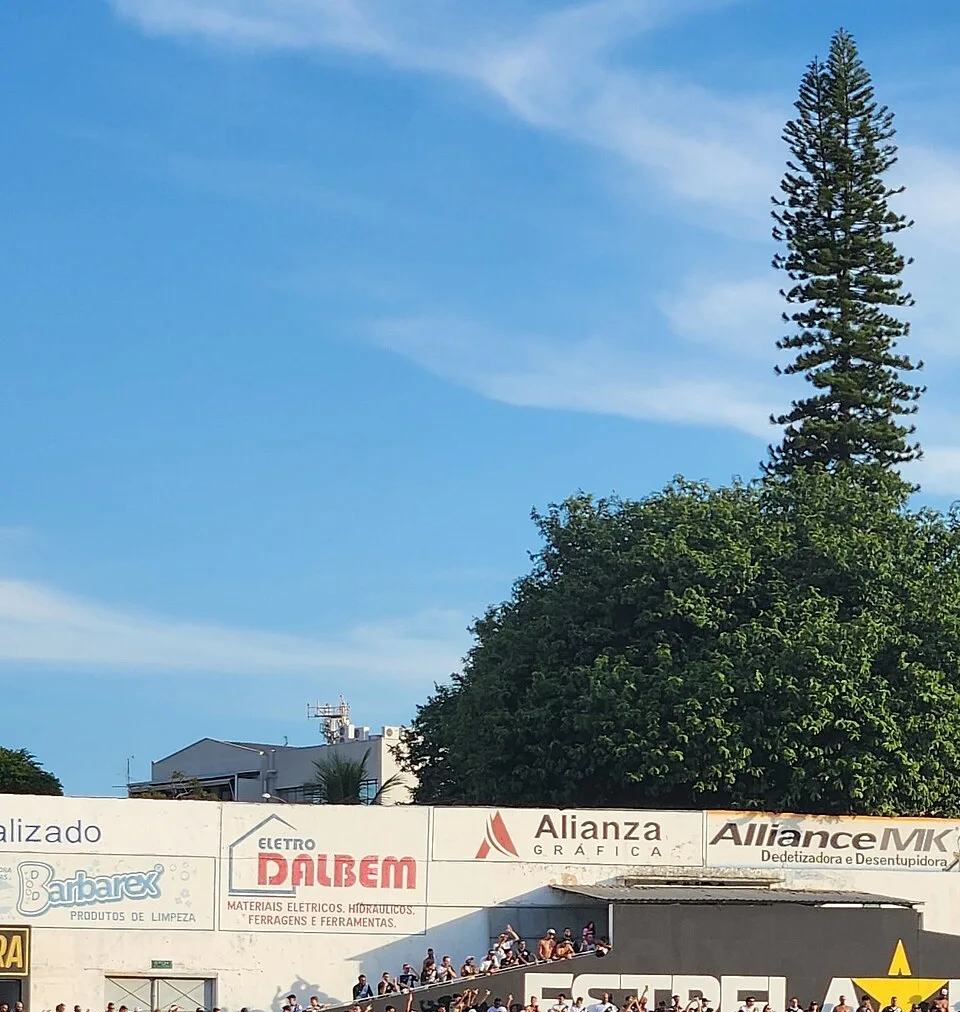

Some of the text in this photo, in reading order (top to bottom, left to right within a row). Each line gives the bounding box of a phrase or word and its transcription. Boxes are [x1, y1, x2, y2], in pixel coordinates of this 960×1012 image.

[534, 813, 662, 842] Alianza
[258, 837, 316, 851] ELETRO
[533, 842, 662, 858] GRÁFICA
[760, 849, 948, 869] Dedetizadora e Desentupidora
[257, 852, 417, 889] DALBEM
[16, 861, 161, 918] Barbarex
[227, 900, 283, 912] MATERIAIS
[70, 910, 196, 923] PRODUTOS DE LIMPEZA
[248, 914, 307, 927] FERRAGENS
[311, 916, 317, 926] E
